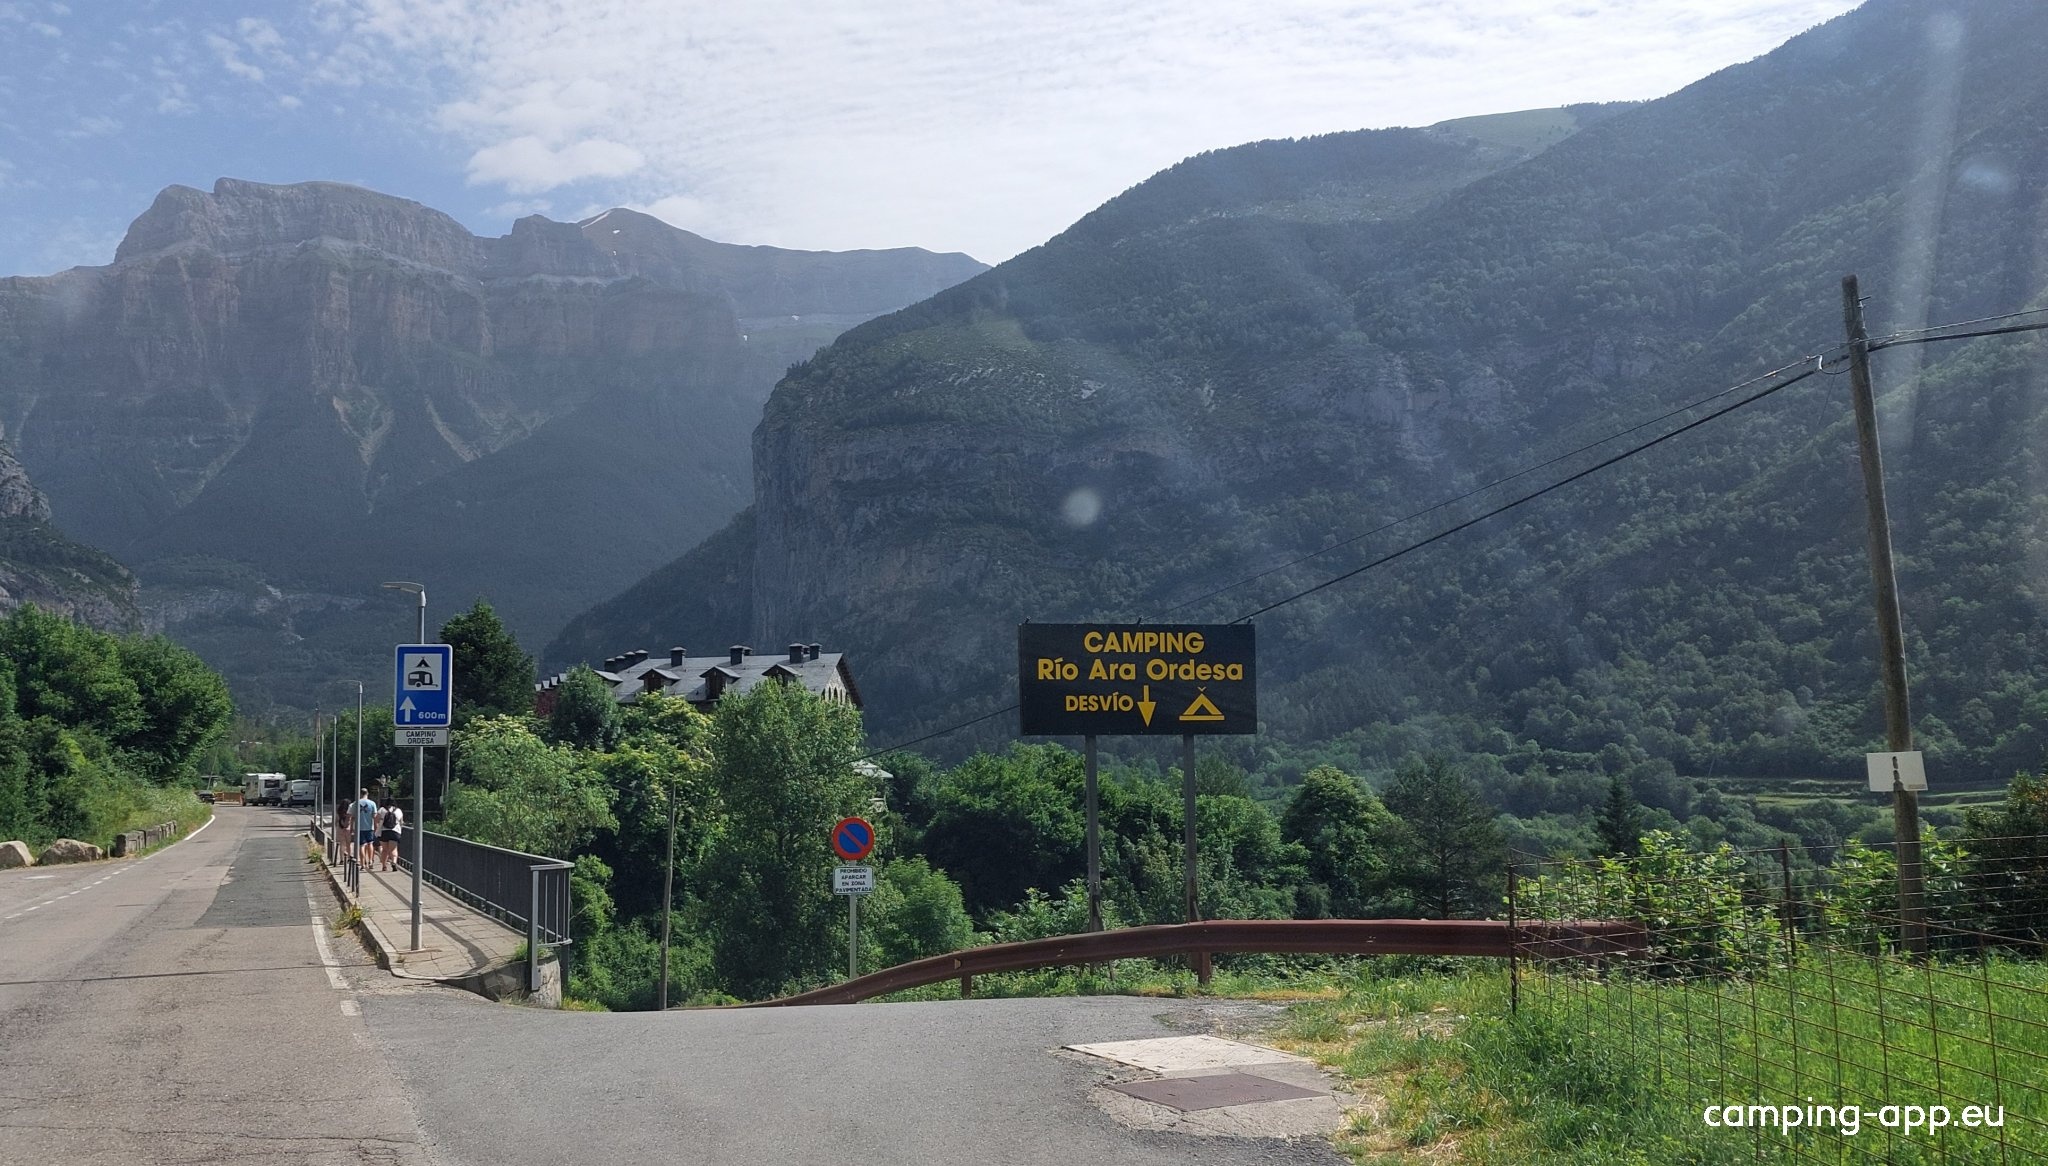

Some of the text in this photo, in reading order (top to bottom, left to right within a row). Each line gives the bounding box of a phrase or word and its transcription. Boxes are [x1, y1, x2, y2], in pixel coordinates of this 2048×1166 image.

[1083, 631, 1205, 654] CAMPING
[1037, 657, 1243, 681] Río Ara Ordesa
[1065, 691, 1134, 712] DESVÍO
[418, 711, 446, 719] 600m
